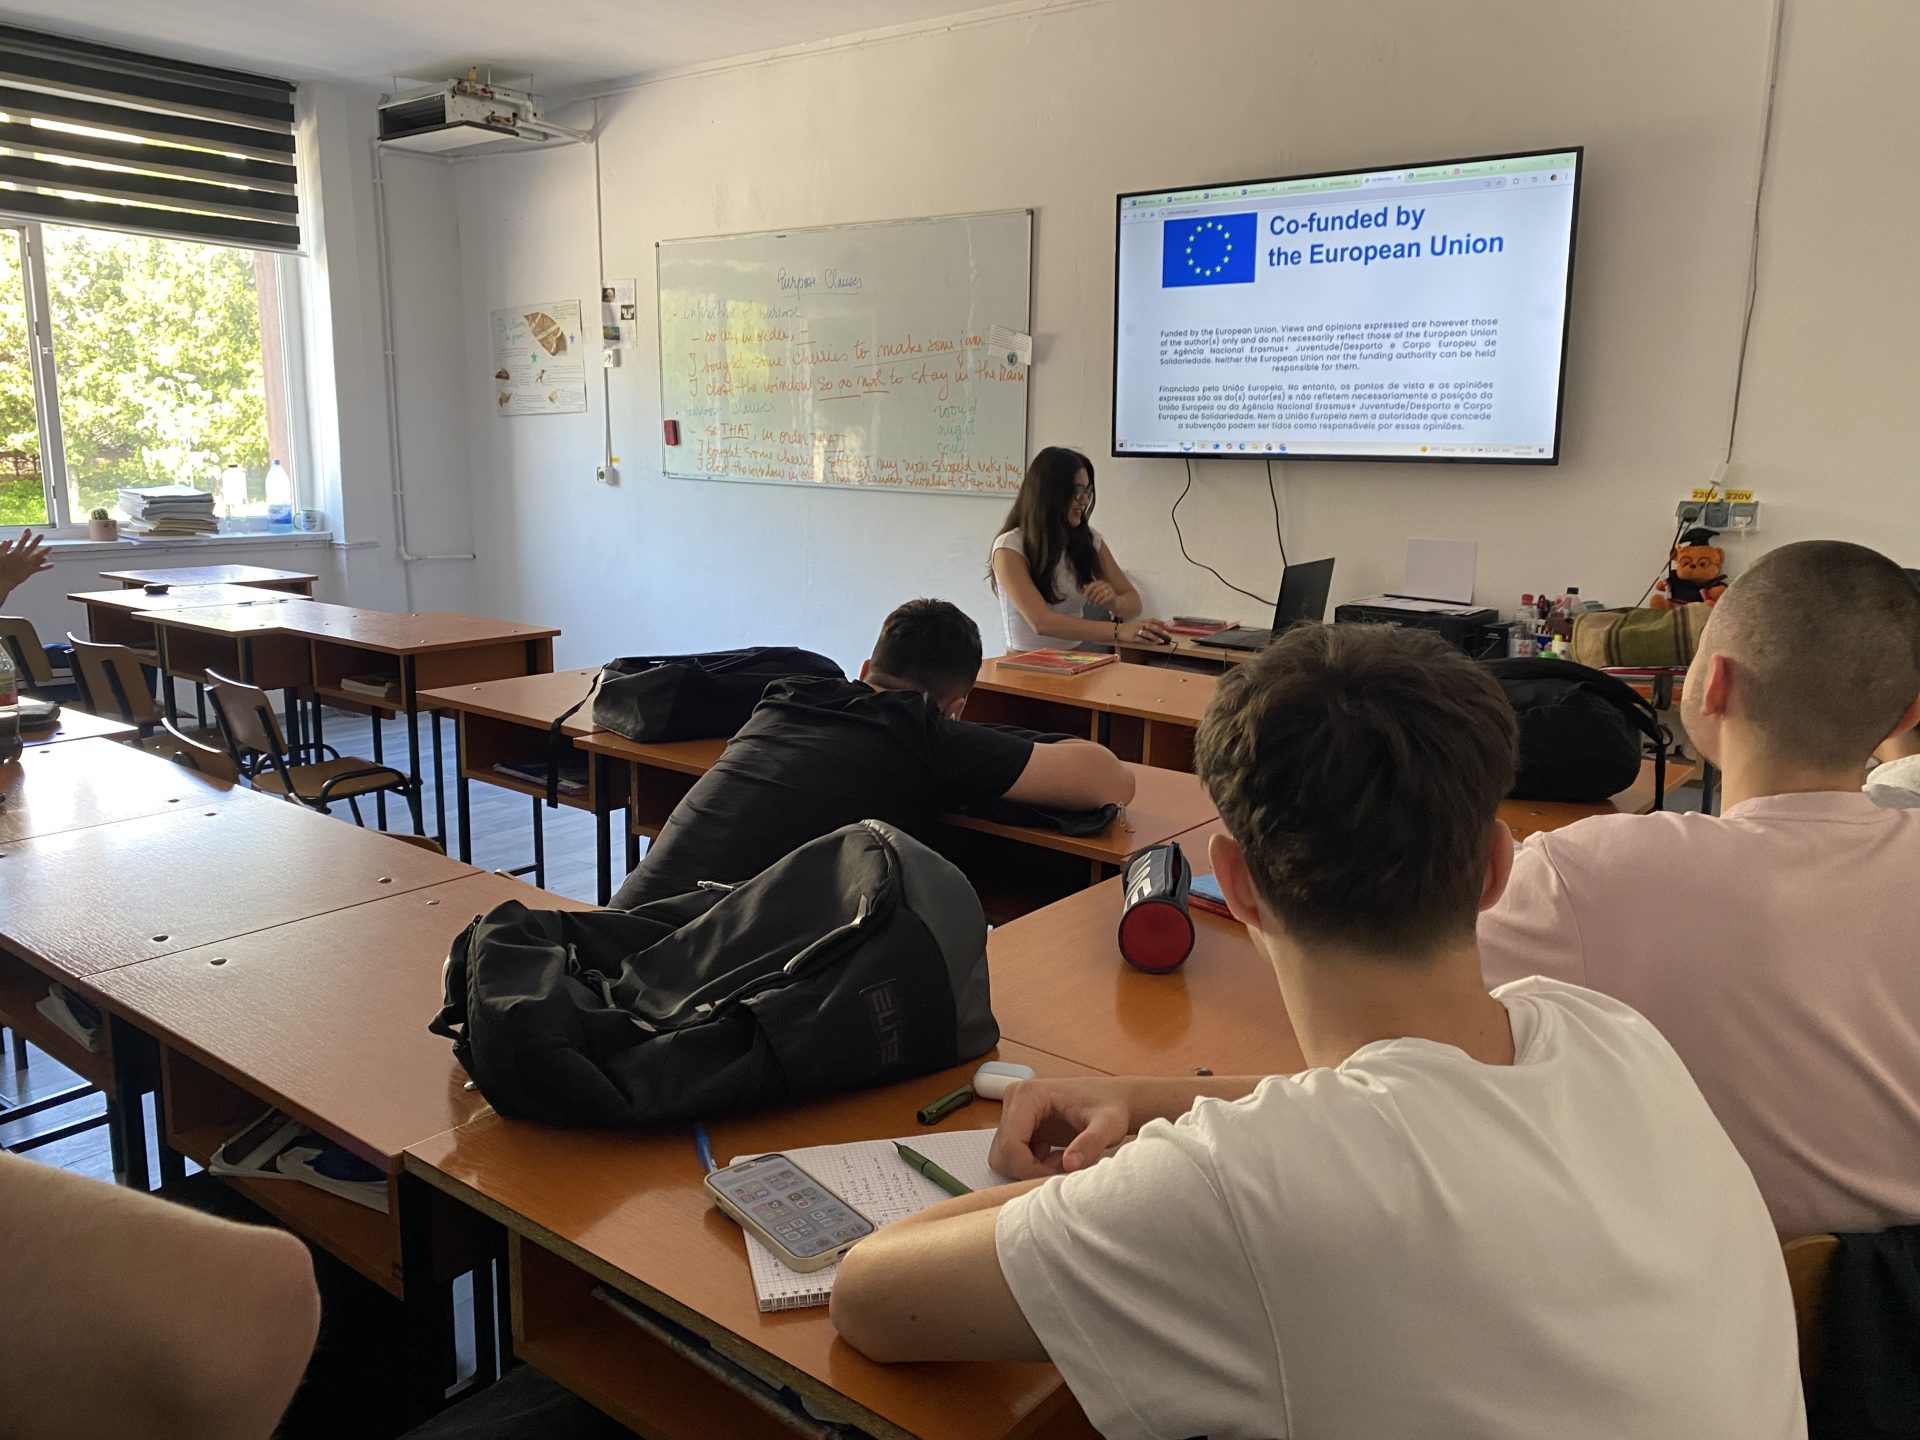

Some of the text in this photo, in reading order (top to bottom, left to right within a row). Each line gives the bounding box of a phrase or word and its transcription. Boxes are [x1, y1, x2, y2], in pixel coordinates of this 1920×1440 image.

[1270, 206, 1425, 235] Co-funded by
[1269, 234, 1504, 266] the European Union
[1161, 328, 1188, 338] Funded
[1190, 328, 1199, 339] by
[1201, 327, 1214, 336] the
[1216, 326, 1252, 338] European
[1282, 324, 1304, 333] Views
[1306, 324, 1324, 332] and
[1325, 322, 1362, 334] opinions
[1364, 321, 1409, 332] expressed
[1430, 318, 1468, 328] however
[1472, 317, 1498, 326] those
[1160, 338, 1168, 347] of
[1170, 338, 1182, 346] the
[1222, 336, 1238, 347] only
[1240, 335, 1256, 344] and
[1258, 335, 1269, 344] do
[1271, 334, 1284, 343] not
[1287, 333, 1334, 344] necessarily
[1336, 332, 1364, 341] reflect
[1367, 331, 1392, 340] those
[1394, 331, 1403, 340] of
[1406, 330, 1421, 339] the
[1424, 329, 1468, 340] European
[1470, 328, 1497, 337] Union
[854, 339, 868, 360] to
[878, 334, 922, 357] make
[1210, 345, 1244, 354] Nacional
[1250, 344, 1288, 353] Erasmus+
[1403, 340, 1431, 351] Corpo
[1438, 339, 1476, 350] Europeu
[1484, 338, 1496, 347] de
[1215, 355, 1242, 364] Neither
[1245, 355, 1258, 363] the
[1260, 354, 1298, 365] European
[1300, 353, 1324, 362] Union
[1343, 352, 1357, 361] the
[1360, 352, 1393, 363] funding
[1396, 351, 1437, 362] authority
[1460, 350, 1472, 358] be
[1475, 349, 1496, 358] held
[1272, 363, 1319, 374] responsible
[1321, 362, 1333, 371] for
[890, 368, 904, 384] to
[912, 364, 948, 400] stay
[1159, 384, 1200, 392] Financiado
[1354, 382, 1384, 392] pontos
[1388, 382, 1400, 390] de
[1404, 381, 1425, 390] vista
[1159, 396, 1195, 404] expressas
[1314, 392, 1349, 401] refletem
[1352, 391, 1428, 400] necessariamente
[1182, 402, 1214, 413] Europeia
[1277, 402, 1313, 411] Nacional
[1316, 402, 1356, 411] Erasmus+
[1463, 401, 1492, 412] Corpo
[1158, 412, 1188, 422] Europeu
[1190, 412, 1199, 420] de
[1258, 412, 1276, 420] Nem
[1310, 411, 1347, 422] Europeia
[1379, 411, 1428, 420] autoridade
[1430, 414, 1448, 422] que
[1450, 411, 1491, 420] concede
[1228, 421, 1256, 432] podem
[1272, 421, 1292, 430] tidos
[1378, 424, 1392, 432] por
[1692, 490, 1718, 500] 220V
[1726, 492, 1752, 500] 220V
